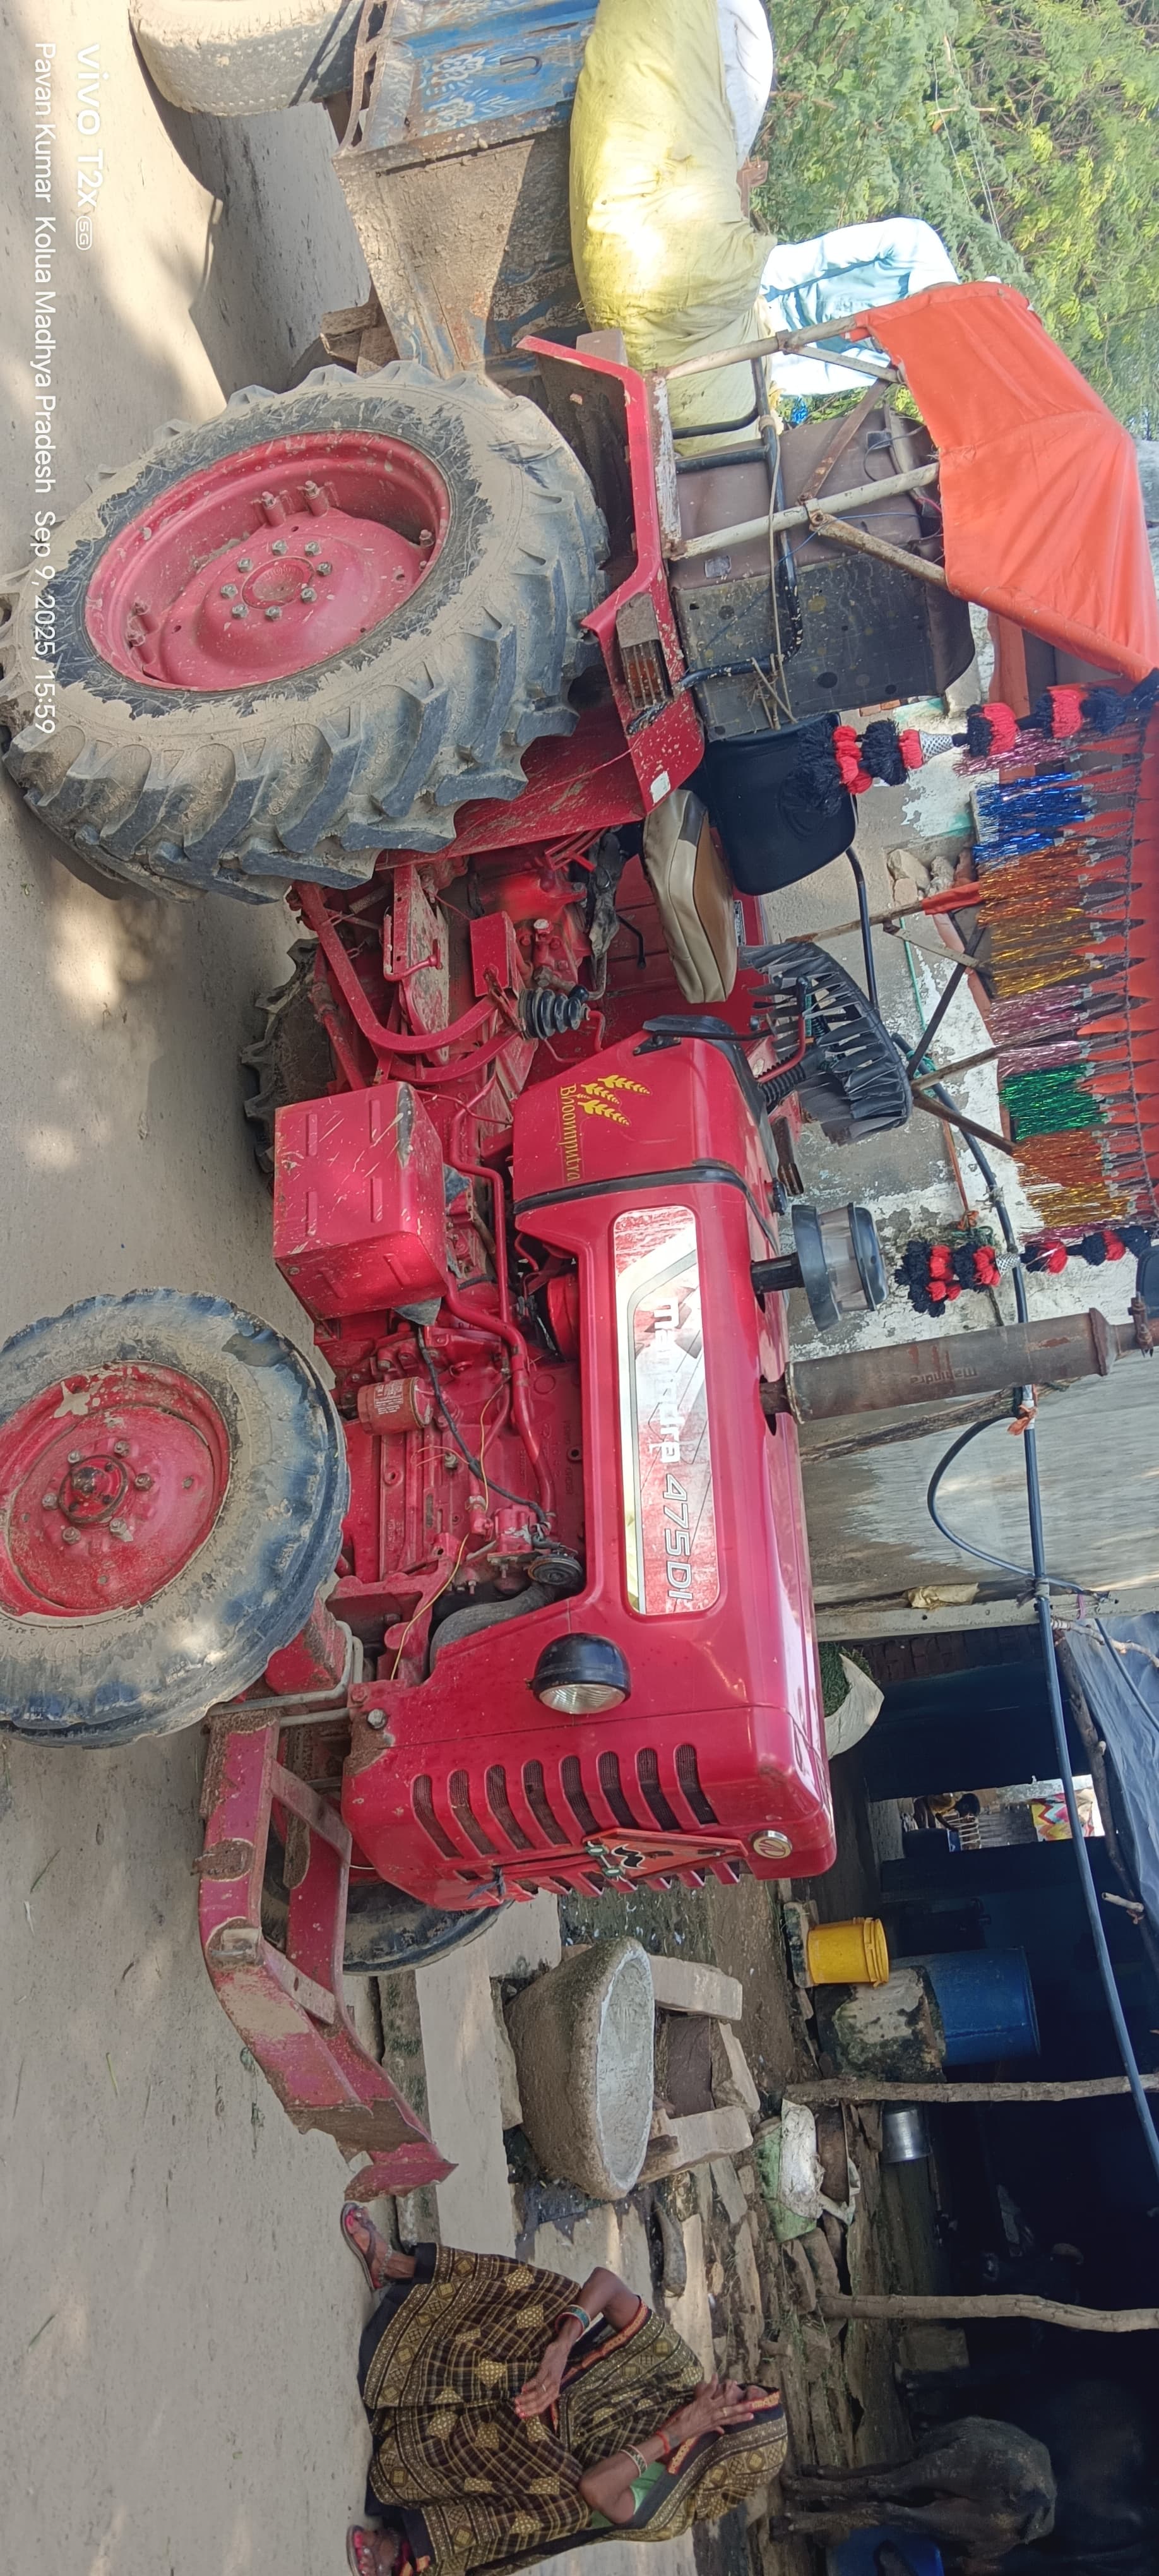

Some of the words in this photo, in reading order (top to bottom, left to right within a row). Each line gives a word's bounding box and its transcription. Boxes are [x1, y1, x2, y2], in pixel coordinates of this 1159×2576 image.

[557, 1083, 582, 1182] Bhoomiputra
[663, 1474, 691, 1556] 475
[666, 1561, 693, 1601] DI
